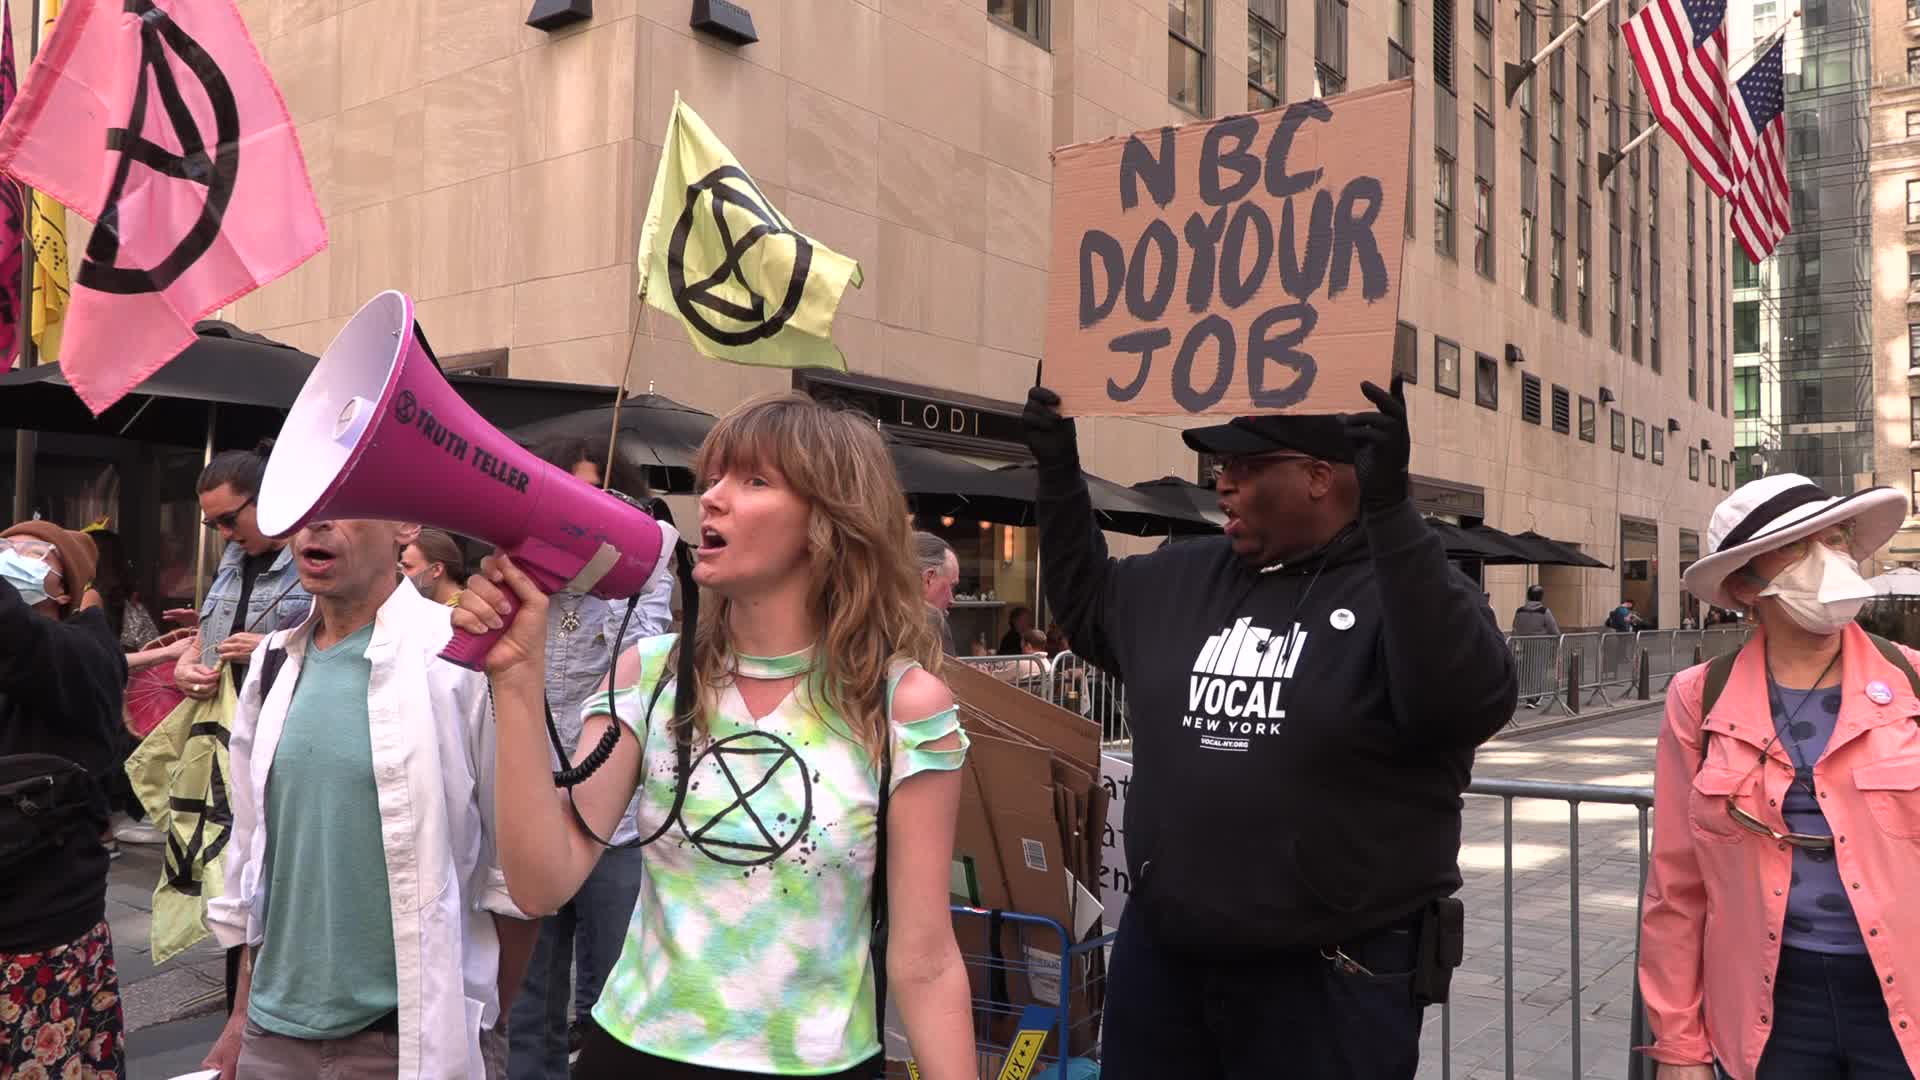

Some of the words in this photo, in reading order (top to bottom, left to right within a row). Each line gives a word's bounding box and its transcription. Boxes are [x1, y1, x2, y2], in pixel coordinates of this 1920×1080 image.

[1119, 98, 1333, 213] NBC
[1107, 302, 1318, 412] JOB
[901, 399, 979, 436] LODI
[415, 409, 468, 461] TRUTH
[471, 446, 529, 494] TELLER
[1189, 675, 1286, 719] VOCAL
[1182, 715, 1220, 732] NEW
[1228, 721, 1281, 735] YORK
[1200, 737, 1249, 748] VOCAL-NY.ORG
